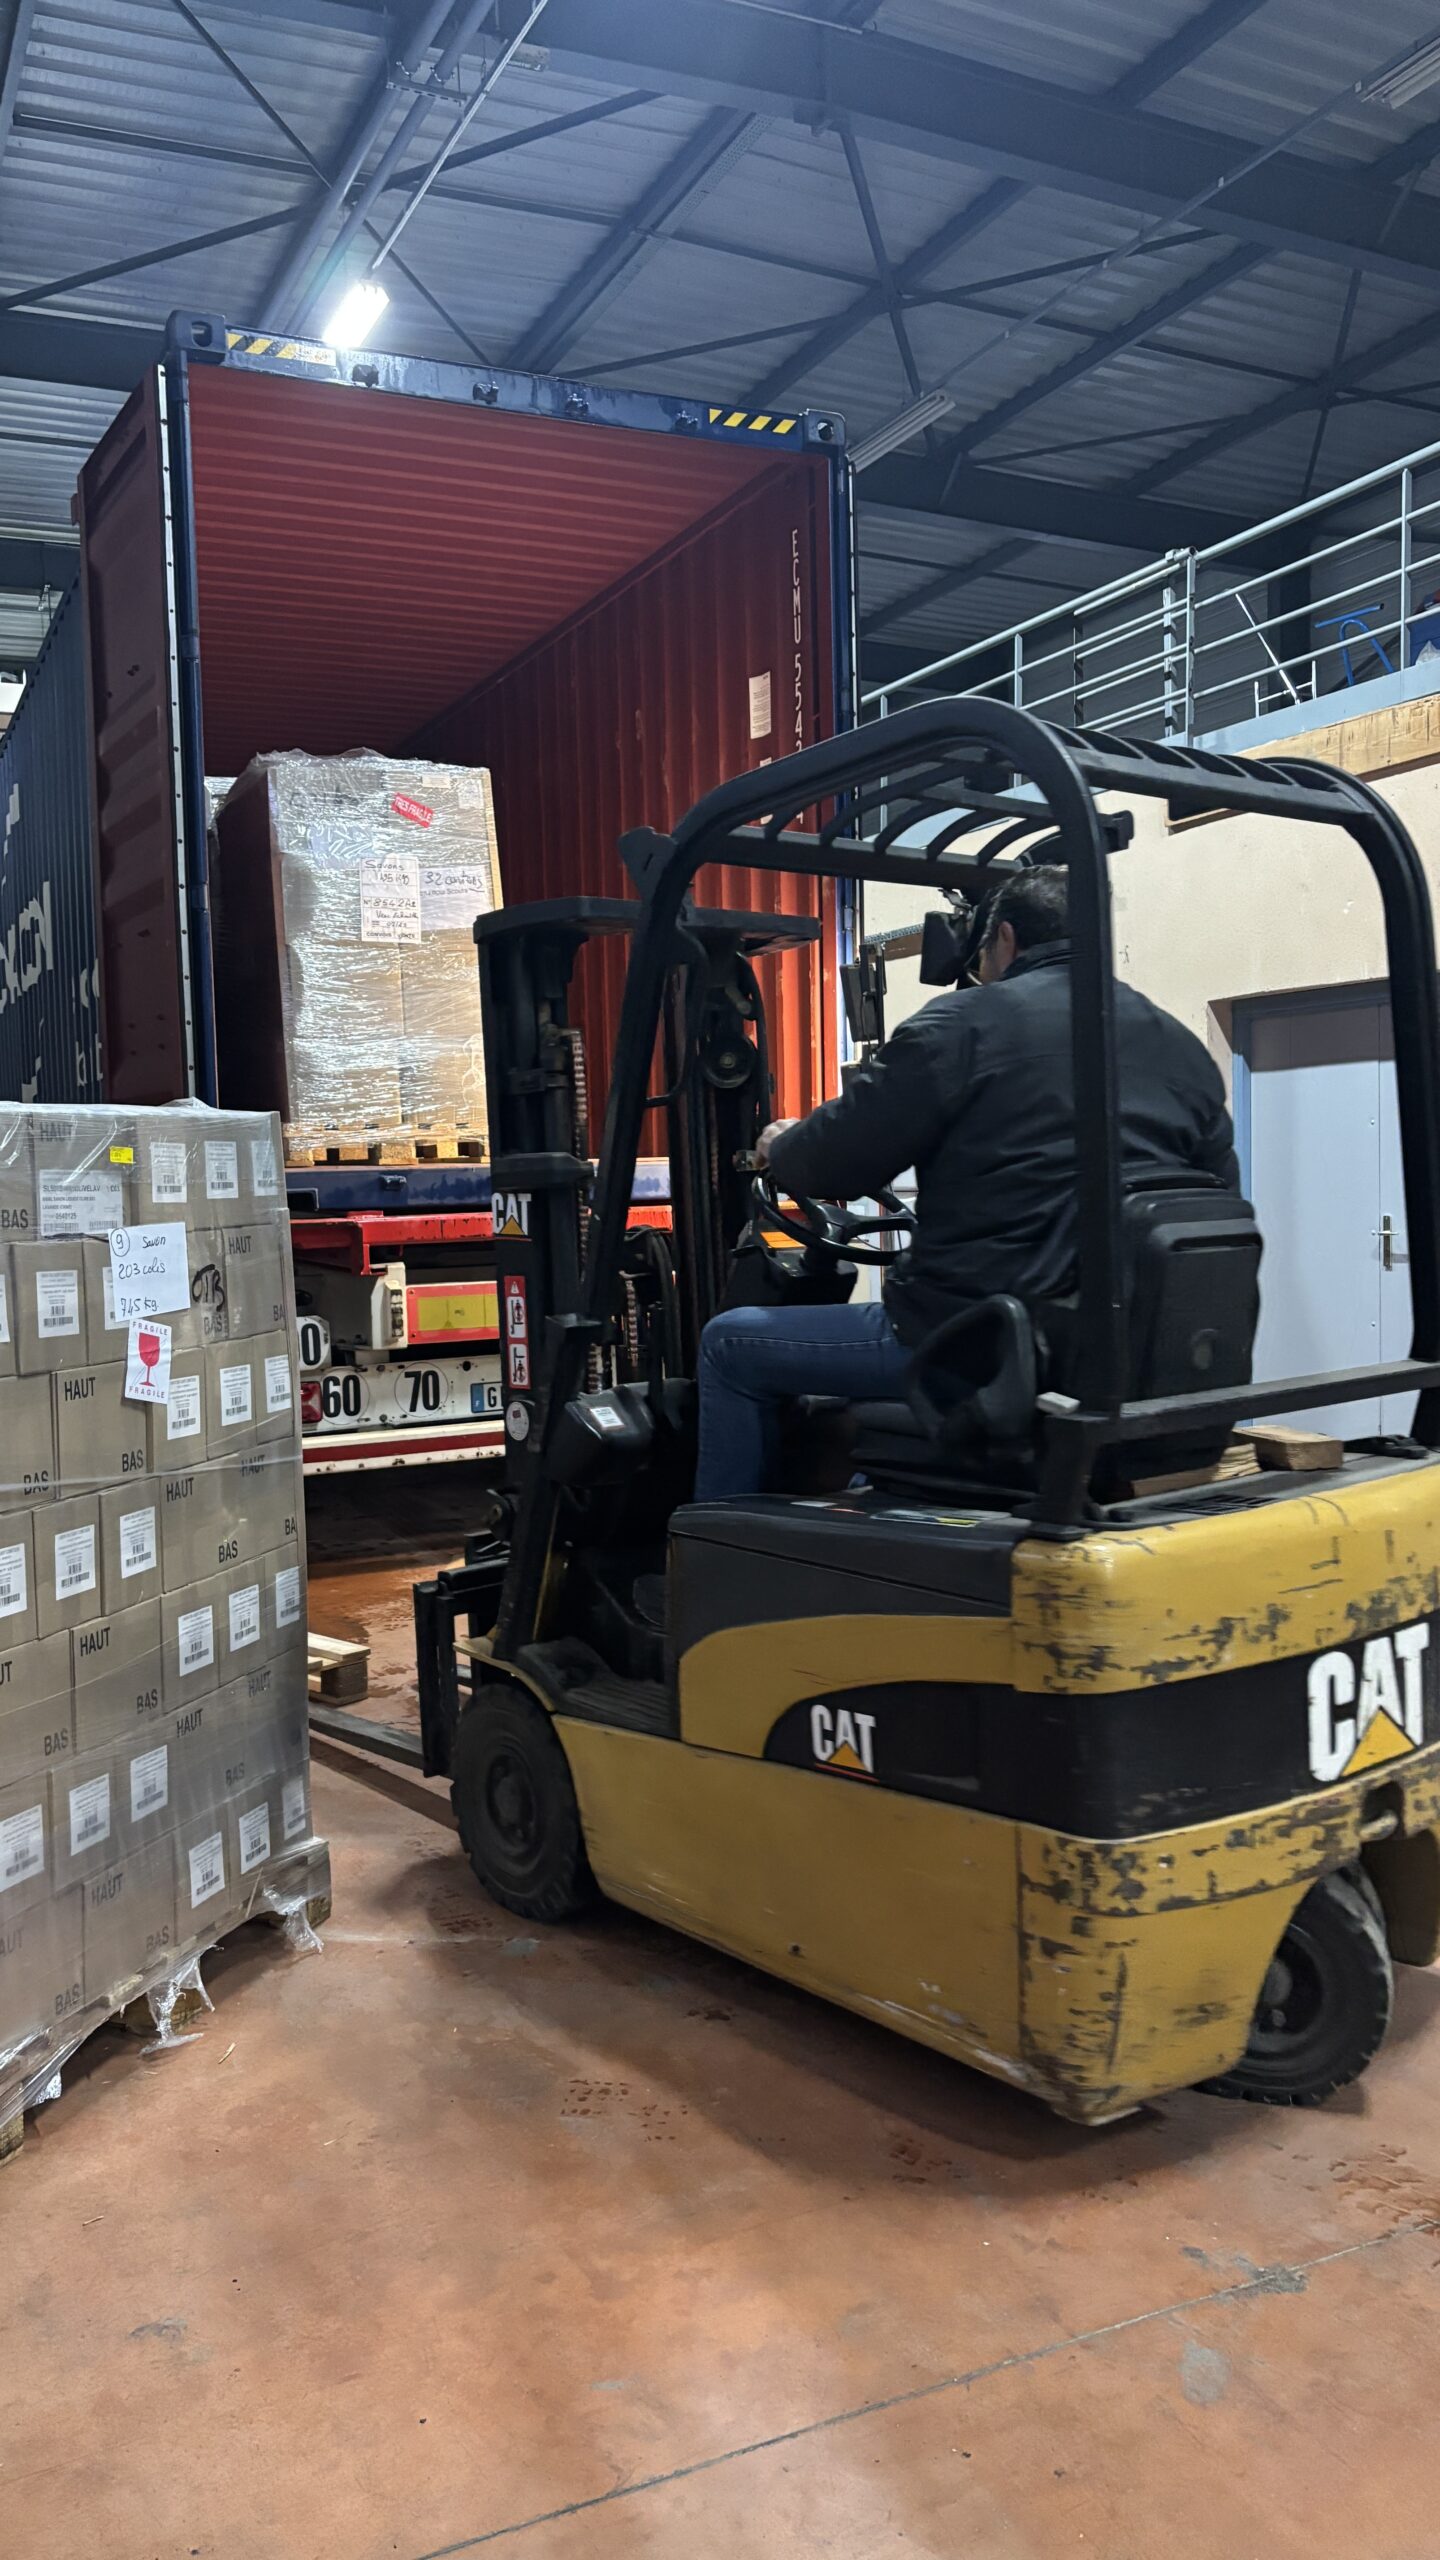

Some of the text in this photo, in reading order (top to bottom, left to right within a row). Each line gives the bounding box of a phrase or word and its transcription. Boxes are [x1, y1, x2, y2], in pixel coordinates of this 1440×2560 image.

[791, 529, 802, 644] ECMU
[424, 871, 443, 886] 32
[1, 1208, 29, 1229] BAS
[491, 1192, 532, 1236] CAT
[115, 1234, 125, 1250] 9
[228, 1236, 252, 1255] HAUT
[118, 1263, 141, 1279] 203
[203, 1314, 223, 1335] BAS
[273, 1303, 286, 1322] BA
[132, 1321, 169, 1337] FRAGILE
[64, 1377, 96, 1402] HAUT
[128, 1385, 165, 1399] FRAGILE
[322, 1374, 361, 1418] 60
[404, 1370, 440, 1413] 70
[122, 1450, 144, 1473] BAS
[241, 1455, 266, 1478] HAUT
[23, 1470, 50, 1496] BAS
[166, 1477, 195, 1503] HAUT
[285, 1516, 297, 1536] BA
[218, 1540, 239, 1564] BAS
[80, 1627, 111, 1657] HAUT
[0, 1660, 13, 1686] UT
[248, 1670, 272, 1699] HAUT
[136, 1688, 159, 1715] BAS
[1307, 1622, 1431, 1783] CAT
[176, 1708, 204, 1739] HAUT
[44, 1727, 69, 1757] BAS
[810, 1704, 876, 1774] CAT
[225, 1761, 246, 1787] BAS
[91, 1872, 124, 1907] HAUT
[0, 1928, 23, 1957] AUT
[146, 1924, 170, 1951] BAS
[55, 1983, 81, 2016] BAS
